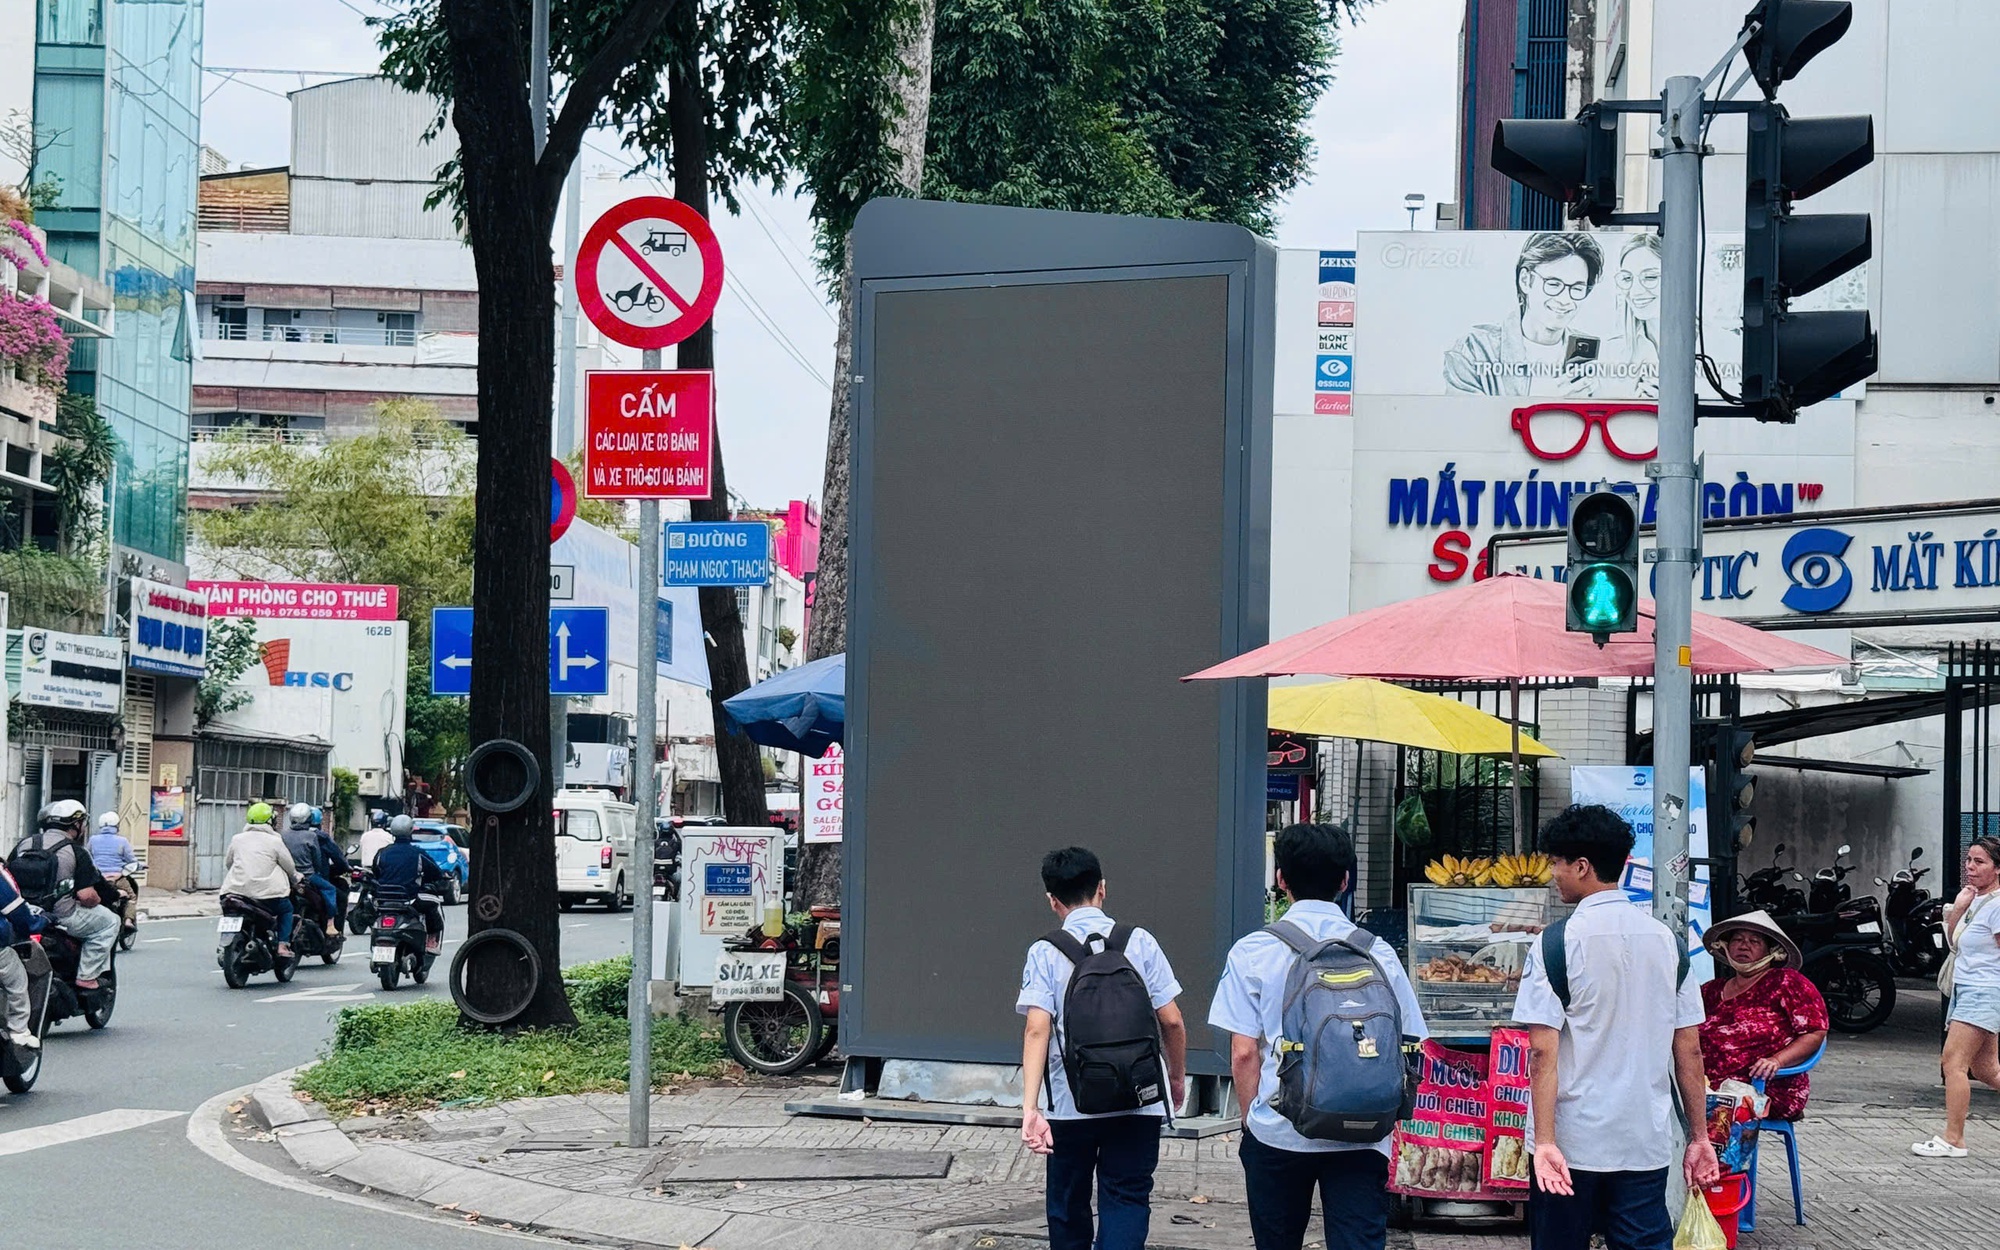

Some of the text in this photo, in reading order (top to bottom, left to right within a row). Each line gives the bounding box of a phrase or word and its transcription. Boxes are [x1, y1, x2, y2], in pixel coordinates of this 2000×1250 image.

[1320, 258, 1356, 268] ZEISS
[1380, 241, 1475, 269] Crizal
[1319, 342, 1348, 350] BLANC
[620, 383, 677, 418] CẤM
[1315, 397, 1351, 411] Cartier
[595, 428, 700, 454] CÁC LOẠI XE 03 BÁNH
[593, 462, 606, 486] VÀ
[608, 467, 622, 486] XE
[624, 463, 645, 486] THÔ
[662, 467, 675, 486] 04
[676, 462, 704, 486] BÁNH
[1389, 462, 1486, 527] MẮT
[1493, 467, 1596, 527] KÍN
[1798, 482, 1824, 504] VIP
[687, 531, 747, 548] ĐƯỜNG
[668, 559, 766, 583] PHẠM NGỌC THẠCH
[1870, 531, 1944, 592] MẮT
[1953, 528, 2000, 588] KÍ
[198, 584, 233, 604] VĂN
[238, 584, 297, 605] PHÒNG
[302, 589, 338, 606] CHO
[342, 587, 388, 608] THUÊ
[226, 606, 358, 618] Liên hệ: 0765 059 175
[365, 626, 392, 636] 162B
[284, 670, 354, 691] HSC
[816, 794, 844, 811] GÒ
[1636, 822, 1654, 836] CHỌ
[720, 959, 782, 982] SỬA XE
[1496, 1036, 1522, 1078] DÌ
[1446, 1096, 1487, 1119] CHIÊN
[1444, 1122, 1486, 1144] CHIÊN
